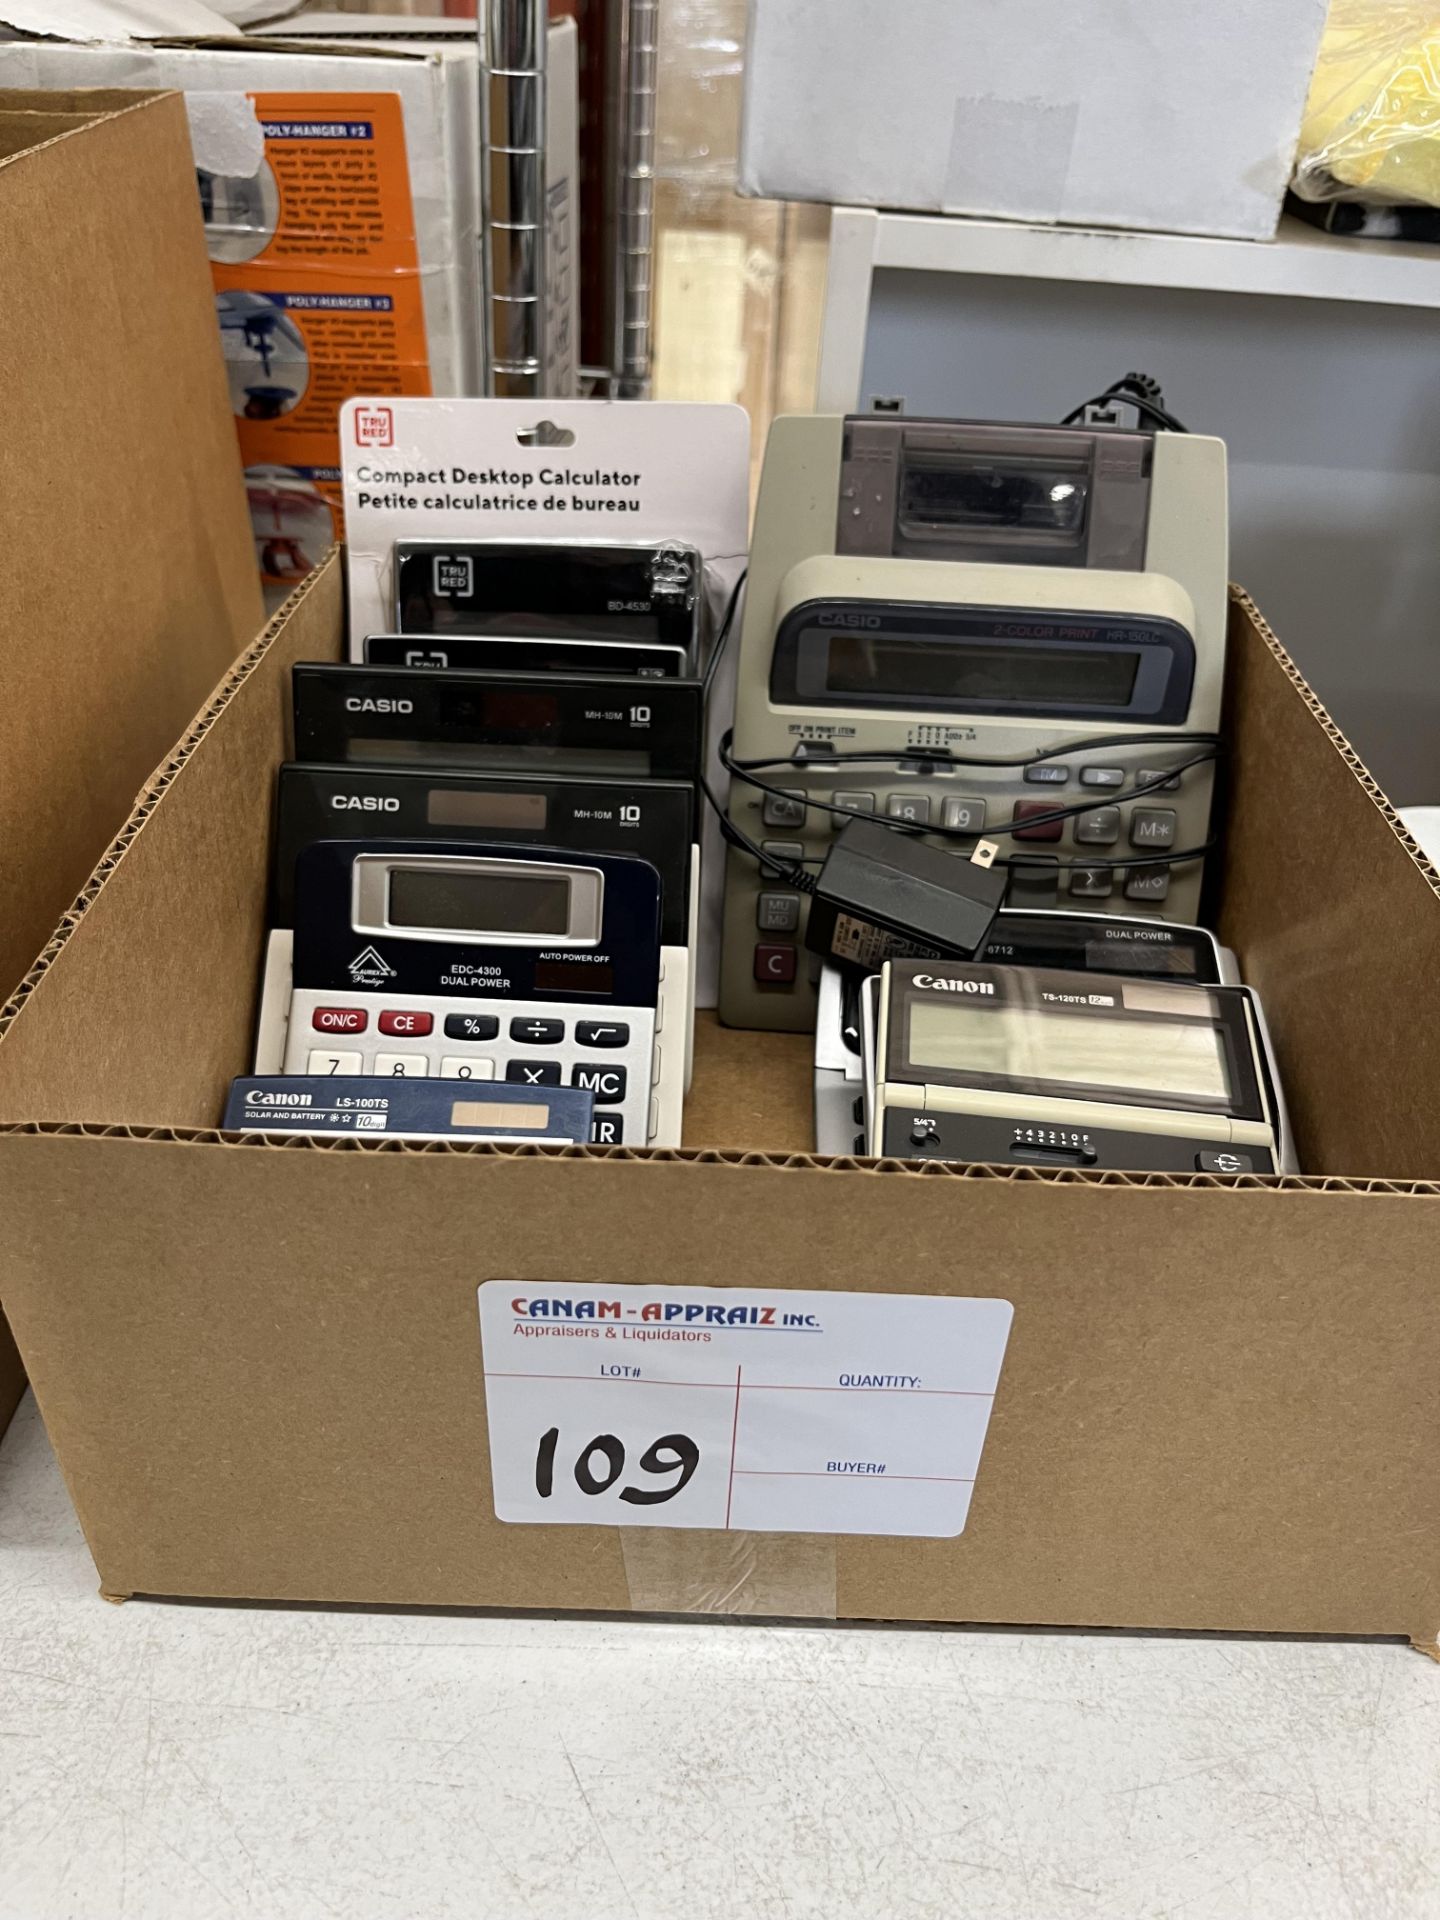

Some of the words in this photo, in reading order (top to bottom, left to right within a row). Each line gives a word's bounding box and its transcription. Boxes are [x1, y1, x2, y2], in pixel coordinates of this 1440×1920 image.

[356, 466, 446, 488] Compact
[452, 468, 534, 489] Desktop
[539, 469, 641, 486] Calculator
[358, 492, 418, 510] Petite
[423, 493, 537, 511] calculatrice
[543, 495, 567, 511] de
[572, 495, 640, 512] bureau
[441, 566, 466, 577] TRU
[440, 577, 466, 588] RED
[818, 613, 881, 629] CASIO
[993, 624, 1053, 638] 2-COLOR
[1058, 626, 1099, 640] PRINT
[346, 697, 414, 714] CASIO
[630, 707, 651, 722] 10
[331, 795, 401, 812] CASIO
[574, 810, 612, 820] MH-10M
[620, 806, 641, 822] 10
[1106, 929, 1132, 939] DUAL
[1134, 931, 1172, 941] POWER
[539, 952, 562, 961] AUTO
[563, 954, 593, 962] POWER
[594, 955, 610, 963] OFF
[767, 955, 782, 974] C
[451, 965, 502, 976] EDC-4300
[441, 976, 470, 986] DUAL
[471, 978, 511, 989] POWER
[912, 974, 994, 995] Canon
[1042, 993, 1087, 1004] TS-120TS
[321, 1012, 358, 1028] ON/C
[393, 1015, 415, 1031] CE
[579, 1073, 620, 1095] MC
[245, 1090, 312, 1106] Canon
[336, 1098, 389, 1109] LS-100TS
[245, 1111, 272, 1119] SOLAR
[291, 1113, 326, 1121] BATTERY
[783, 1314, 820, 1327] INC.
[513, 1323, 600, 1338] Appraisers
[605, 1327, 617, 1338] &
[622, 1328, 712, 1342] Liquidators
[600, 1364, 641, 1378] LOT#
[838, 1373, 922, 1389] QUANTITY:
[535, 1427, 700, 1505] 109
[826, 1461, 887, 1474] BUYER#
